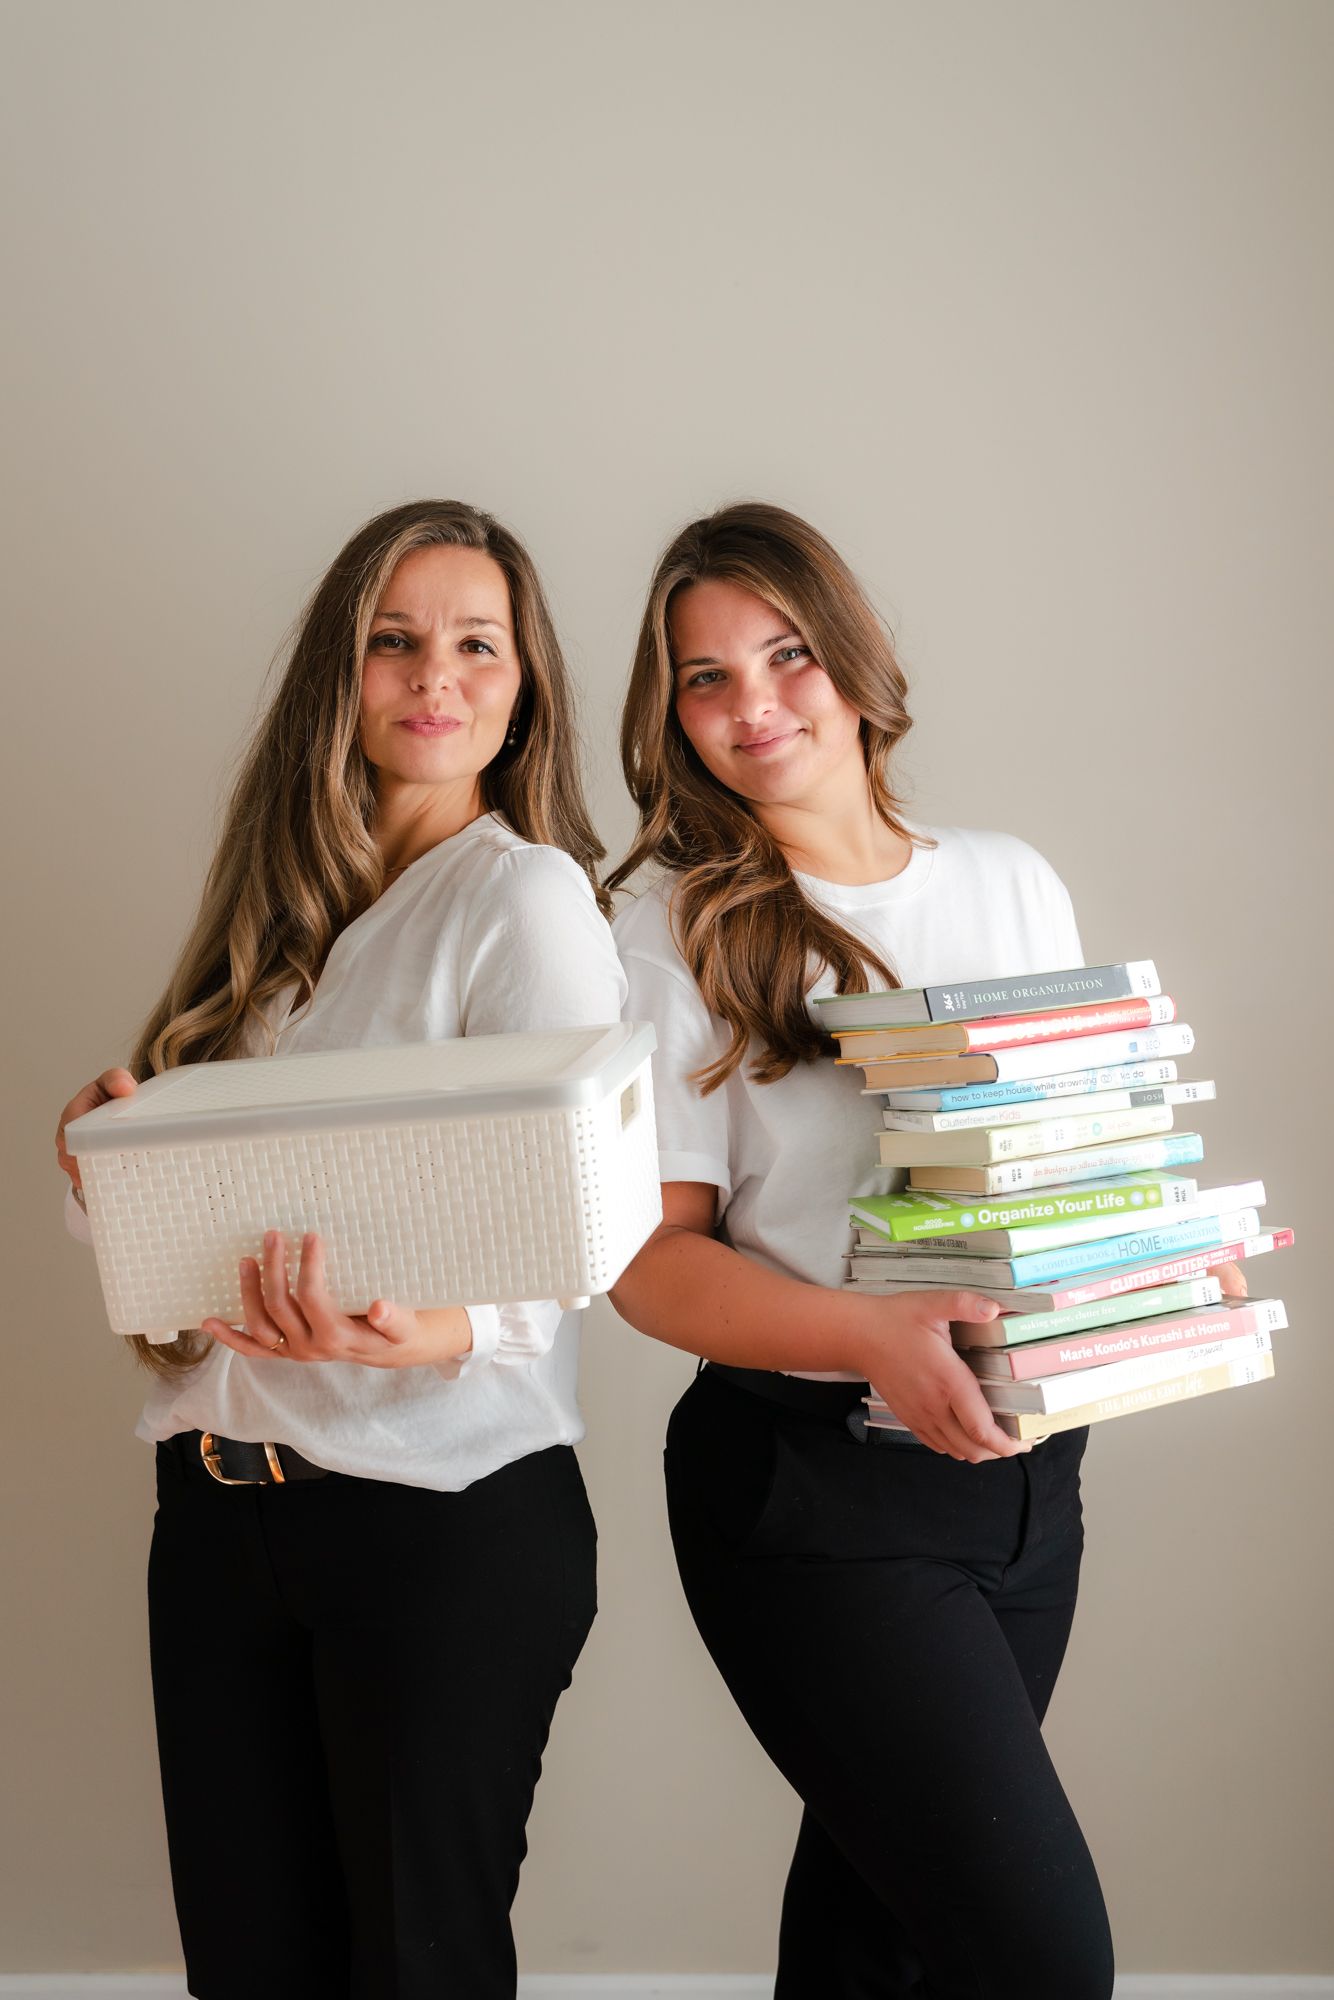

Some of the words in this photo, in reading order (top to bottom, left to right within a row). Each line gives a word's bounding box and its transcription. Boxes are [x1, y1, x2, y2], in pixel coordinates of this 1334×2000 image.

[973, 990, 1008, 1004] HOME
[1012, 979, 1104, 1000] ORGANIZATION
[951, 1093, 969, 1103] how
[971, 1091, 981, 1101] to
[982, 1088, 1005, 1101] keep
[1006, 1084, 1032, 1097] house
[1034, 1081, 1057, 1093] while
[1058, 1076, 1097, 1090] drowning
[939, 1113, 985, 1129] Clutterfree
[998, 1109, 1021, 1121] Kids
[1033, 1169, 1044, 1178] up
[1043, 1164, 1068, 1176] tidying
[978, 1201, 1055, 1226] Organize
[1055, 1195, 1094, 1216] Your
[1096, 1192, 1125, 1209] Life
[1041, 1255, 1084, 1272] COMPLETE
[1086, 1250, 1110, 1264] BOOK
[1117, 1234, 1162, 1258] HOME
[1162, 1225, 1221, 1247] ORGANIZATION
[1223, 1254, 1237, 1263] STYLE
[1110, 1270, 1161, 1294] CLUTTER
[1162, 1254, 1210, 1282] CUTTERS
[1019, 1319, 1048, 1332] making
[1050, 1314, 1074, 1329] space,
[1075, 1308, 1099, 1322] clutter
[1100, 1305, 1117, 1317] free
[1059, 1344, 1094, 1363] Marie
[1094, 1336, 1140, 1357] Kondo's
[1140, 1328, 1183, 1348] Kurashi
[1184, 1326, 1197, 1340] at
[1197, 1319, 1230, 1335] Home
[1096, 1396, 1120, 1415] THE
[1120, 1387, 1156, 1411] HOME
[1156, 1382, 1182, 1401] EDIT
[1183, 1372, 1205, 1395] life
